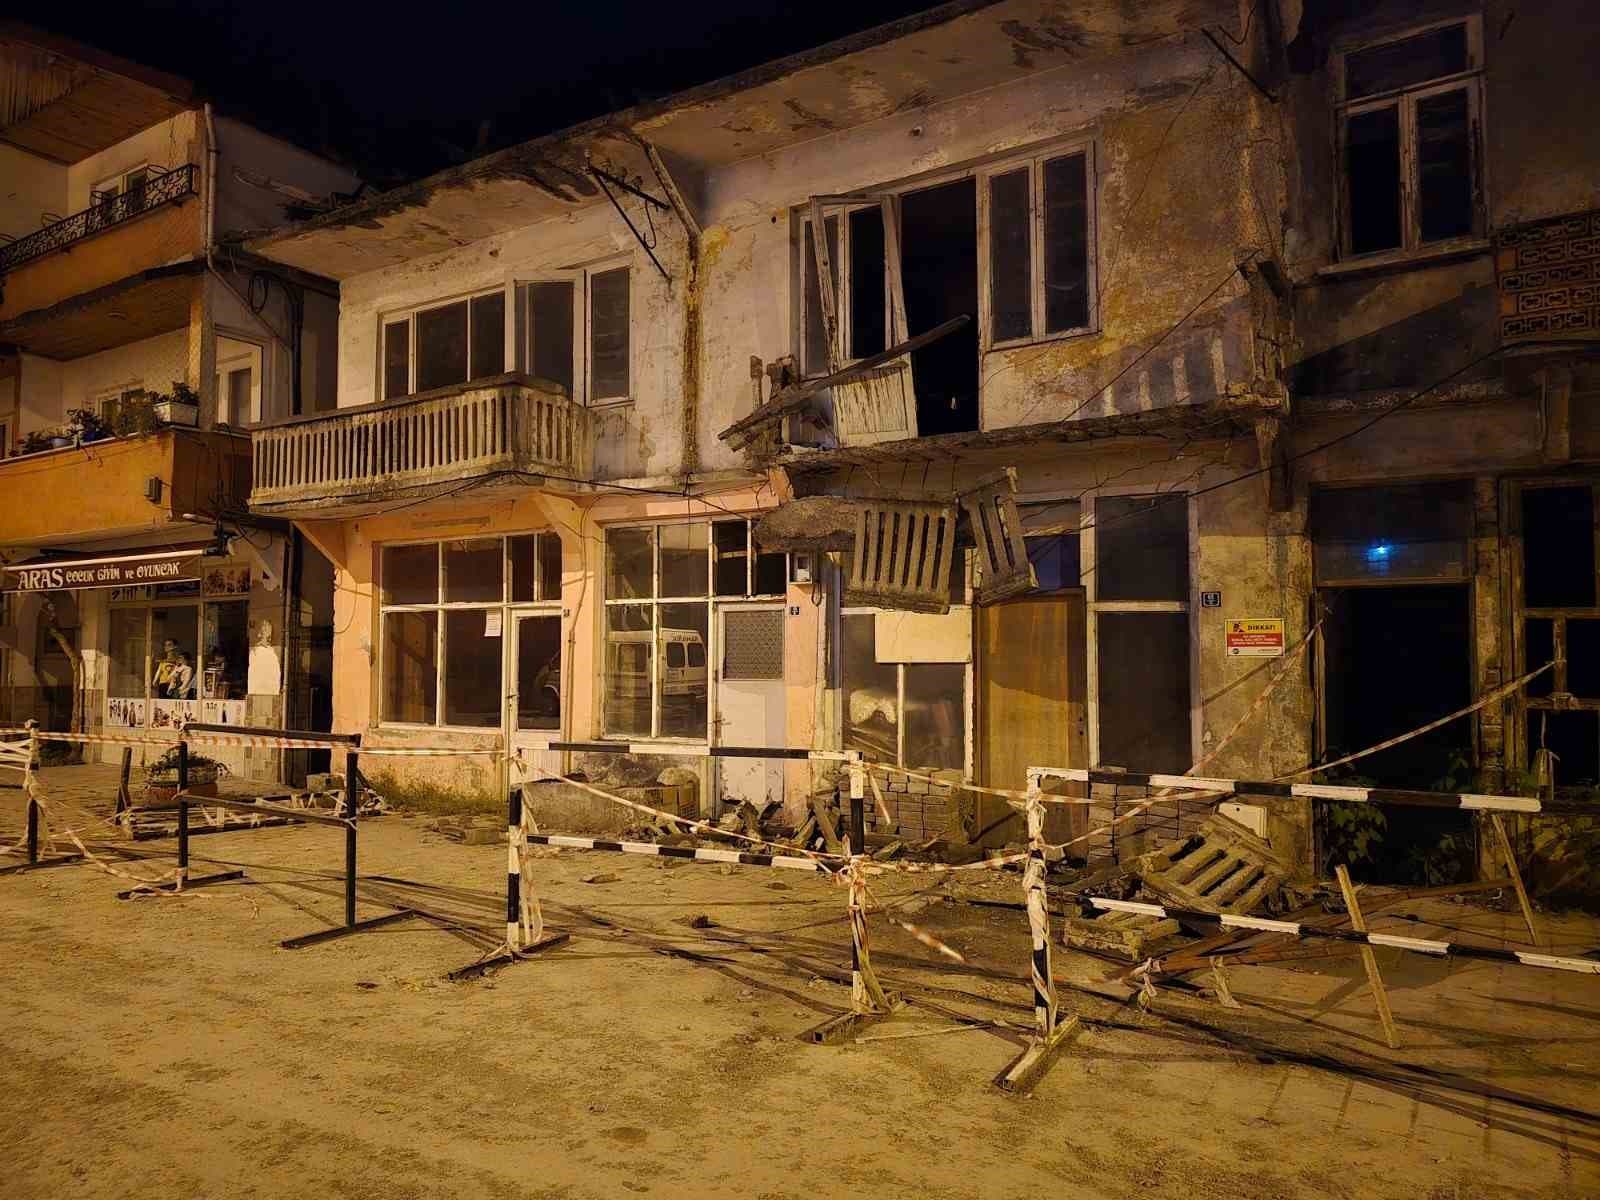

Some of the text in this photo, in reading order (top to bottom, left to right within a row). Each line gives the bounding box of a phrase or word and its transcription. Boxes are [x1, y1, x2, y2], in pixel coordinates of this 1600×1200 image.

[18, 568, 63, 589] ARAS
[125, 569, 135, 579] ve
[136, 562, 180, 578] OYUNCAK
